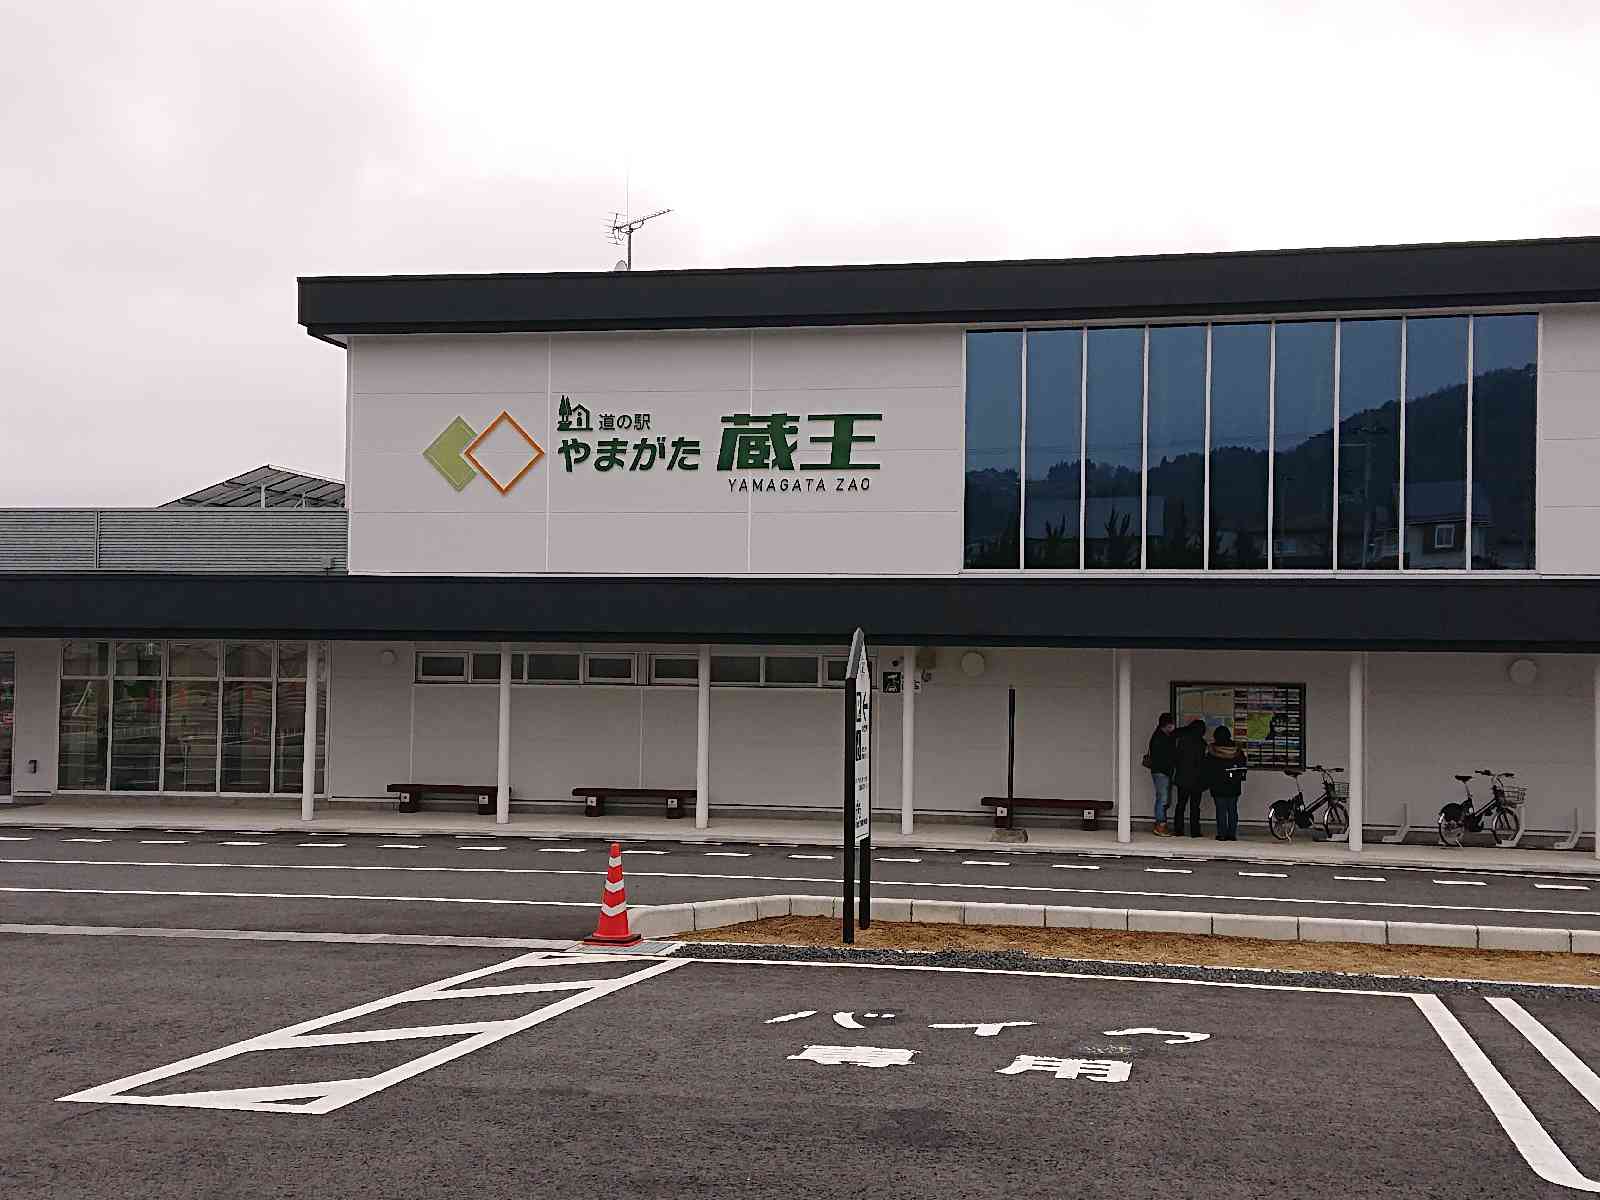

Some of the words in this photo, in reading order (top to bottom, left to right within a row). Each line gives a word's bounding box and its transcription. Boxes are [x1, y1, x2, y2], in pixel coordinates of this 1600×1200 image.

[598, 413, 651, 432] 道の駅
[557, 437, 701, 472] やまがた
[716, 413, 883, 471] 蔵王
[727, 477, 827, 493] YAMAGATA
[835, 477, 871, 492] ZAO
